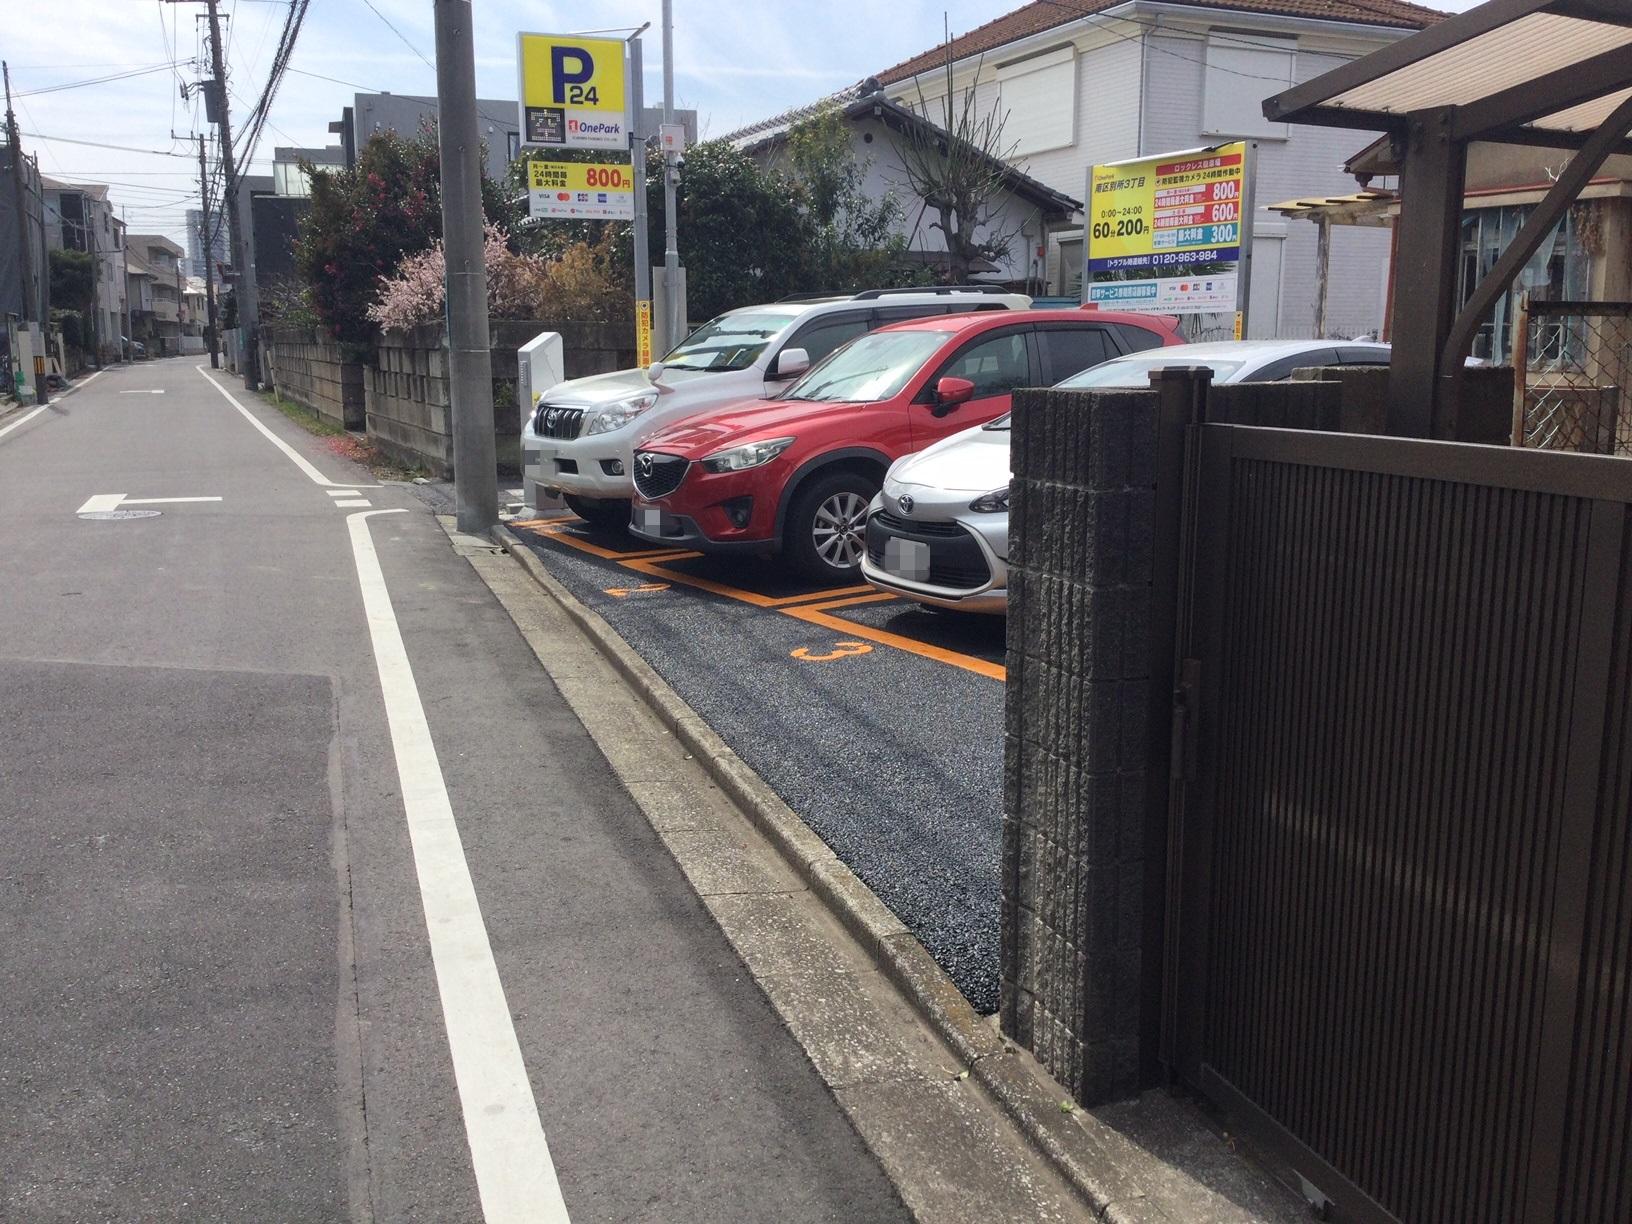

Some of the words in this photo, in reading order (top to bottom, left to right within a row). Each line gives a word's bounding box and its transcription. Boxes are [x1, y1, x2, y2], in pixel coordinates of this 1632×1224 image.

[551, 46, 594, 104] P
[569, 86, 599, 105] 24
[579, 122, 620, 134] OnePark
[1095, 176, 1146, 193] 南区別所3丁目
[1152, 250, 1217, 265] 0120-963-984
